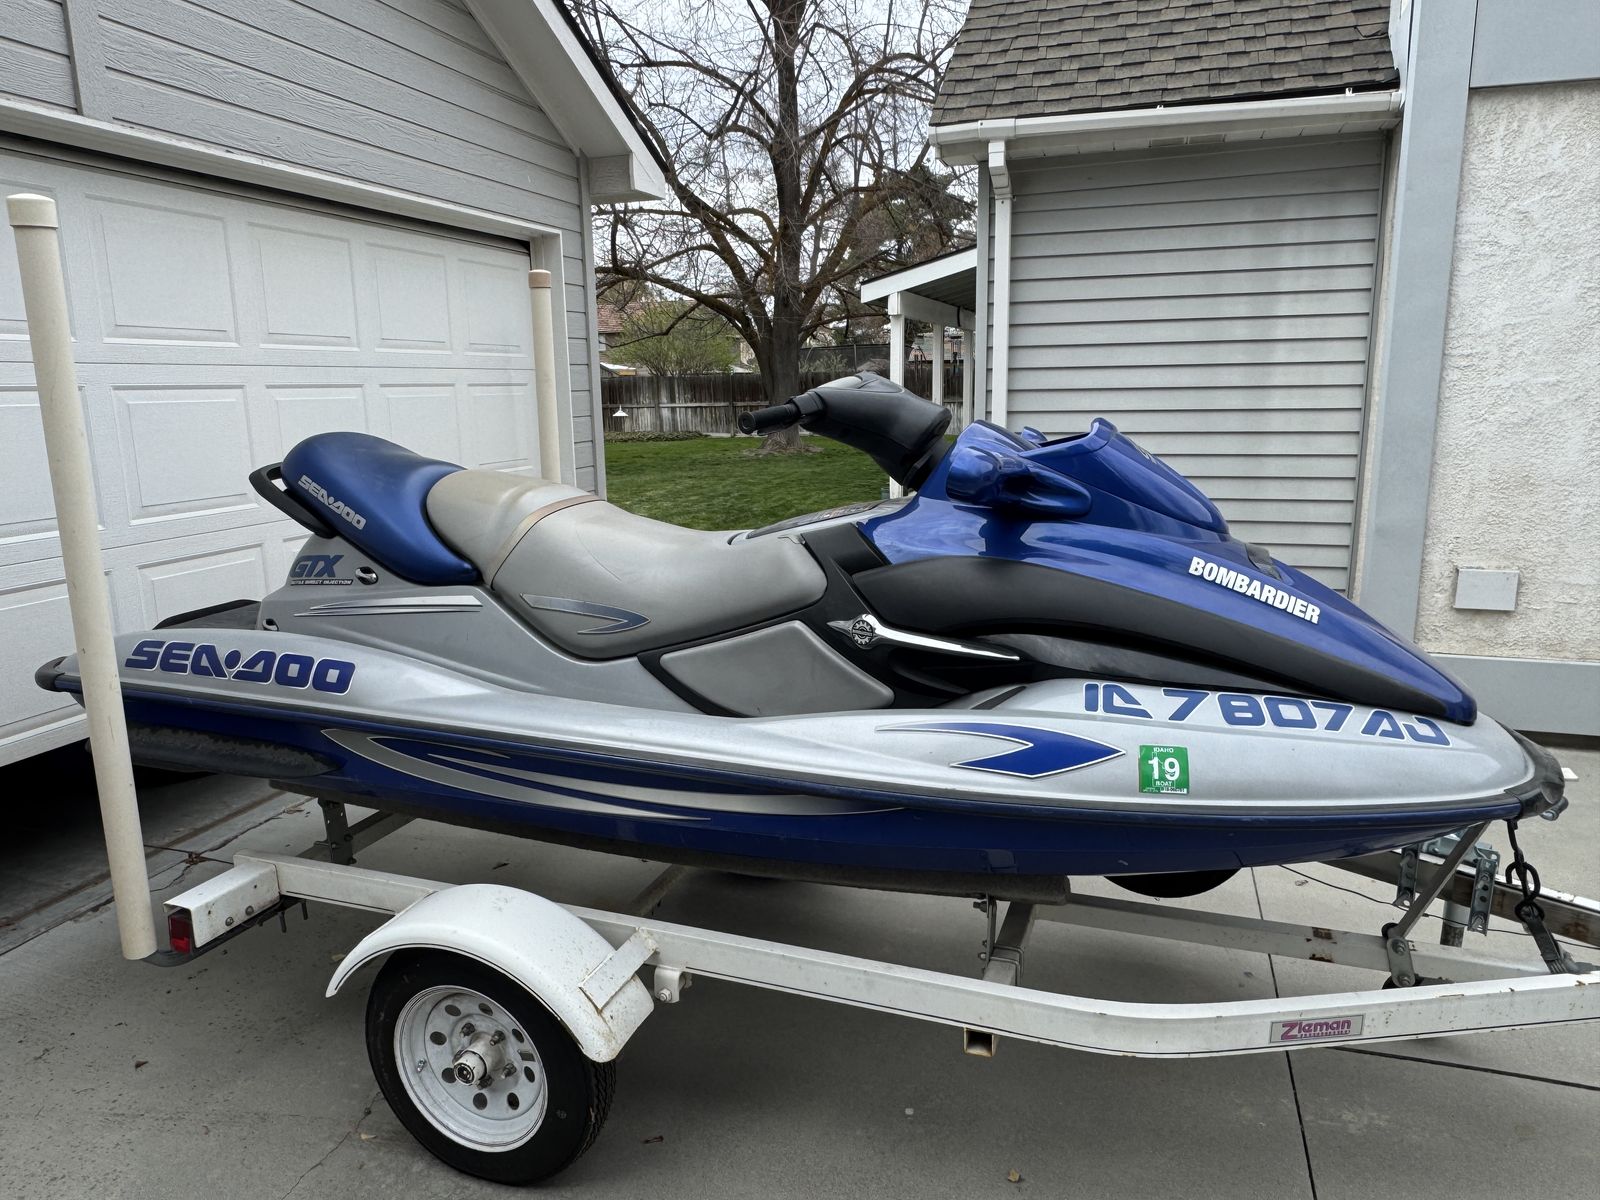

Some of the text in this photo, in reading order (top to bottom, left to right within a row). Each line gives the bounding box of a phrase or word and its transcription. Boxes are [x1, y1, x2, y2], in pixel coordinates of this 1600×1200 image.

[289, 554, 344, 578] GTX
[1188, 556, 1321, 625] BOMBARDIER
[1161, 687, 1355, 732] 7807
[1360, 708, 1452, 747] AJ
[1148, 756, 1180, 781] 19
